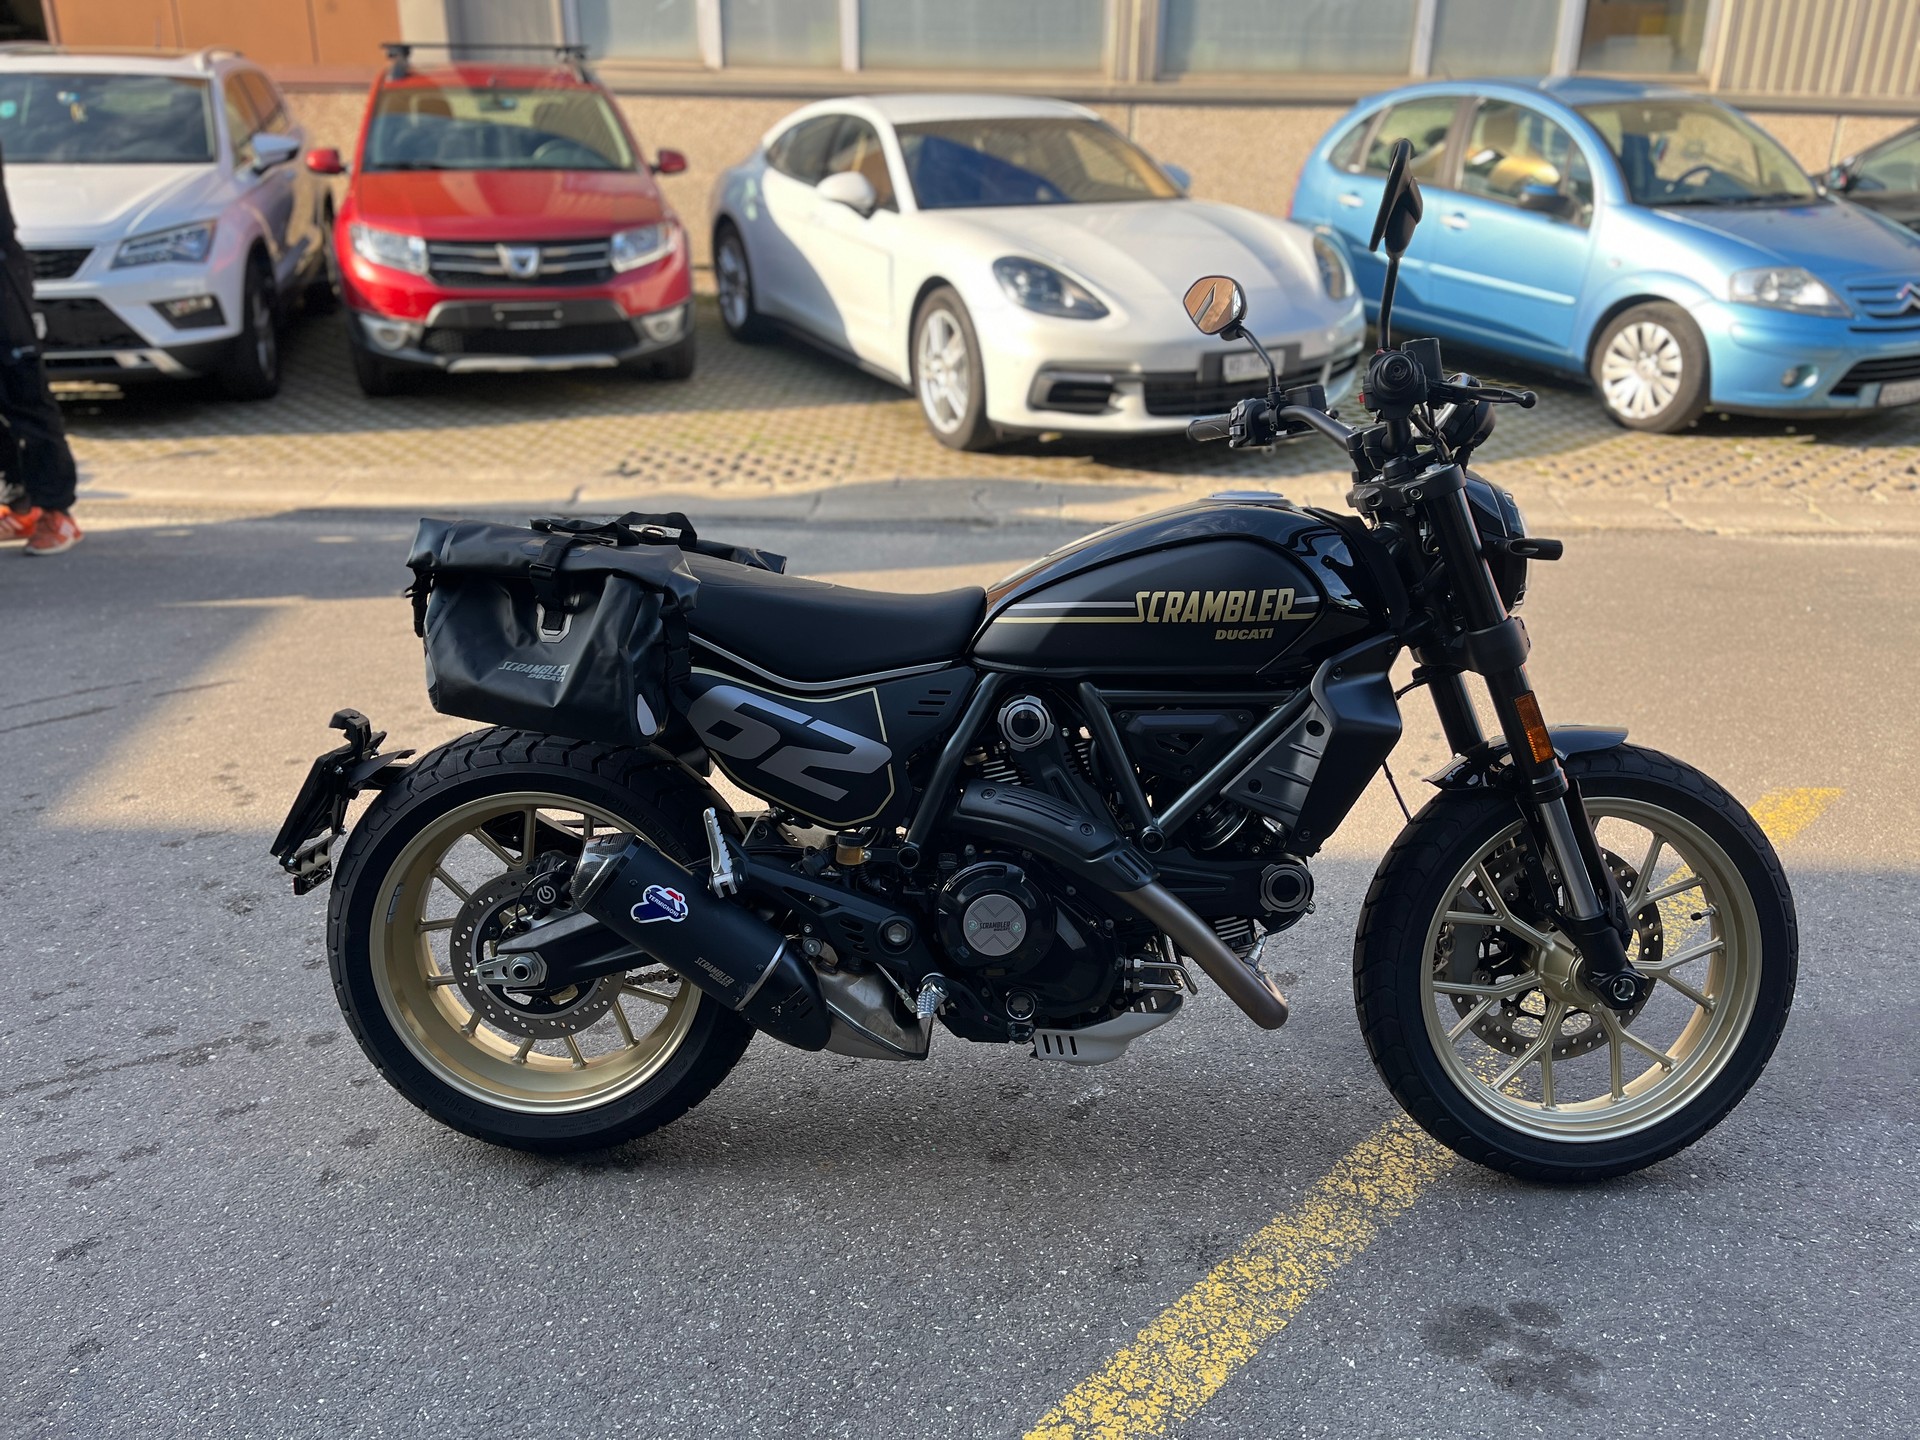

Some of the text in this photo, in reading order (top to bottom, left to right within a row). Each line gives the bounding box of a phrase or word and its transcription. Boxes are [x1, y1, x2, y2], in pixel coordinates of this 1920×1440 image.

[1136, 588, 1296, 623] SCRAMBLER
[1215, 628, 1274, 640] DUCATI
[498, 661, 570, 677] SCRAMBLER
[687, 684, 893, 802] 62
[648, 893, 680, 918] TERMIGNONI
[980, 921, 1011, 930] SCRAMBLER
[694, 956, 735, 984] SCRAMBLER
